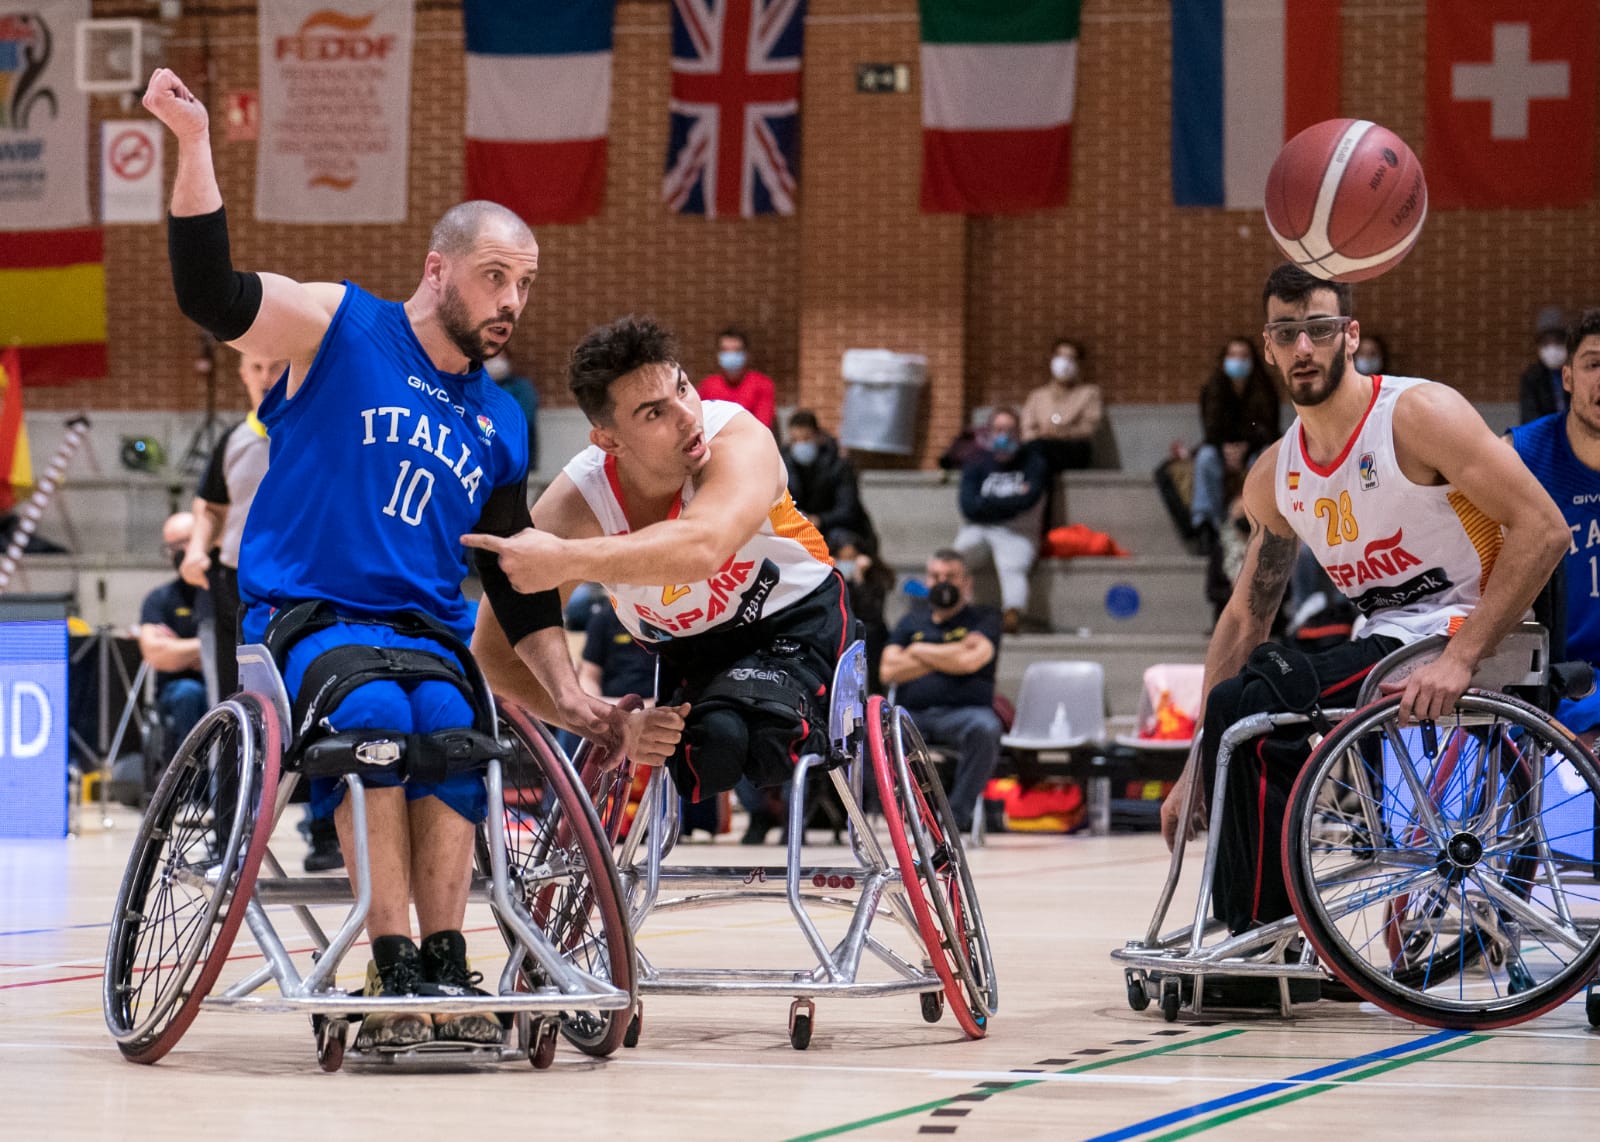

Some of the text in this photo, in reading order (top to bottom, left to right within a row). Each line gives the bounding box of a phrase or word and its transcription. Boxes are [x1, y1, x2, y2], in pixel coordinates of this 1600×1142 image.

[407, 375, 466, 418] GIVOA
[360, 406, 484, 504] ITALIA
[382, 460, 435, 526] 10
[1314, 490, 1358, 546] 28
[1324, 527, 1423, 588] SPAÑA
[0, 681, 52, 759] D
